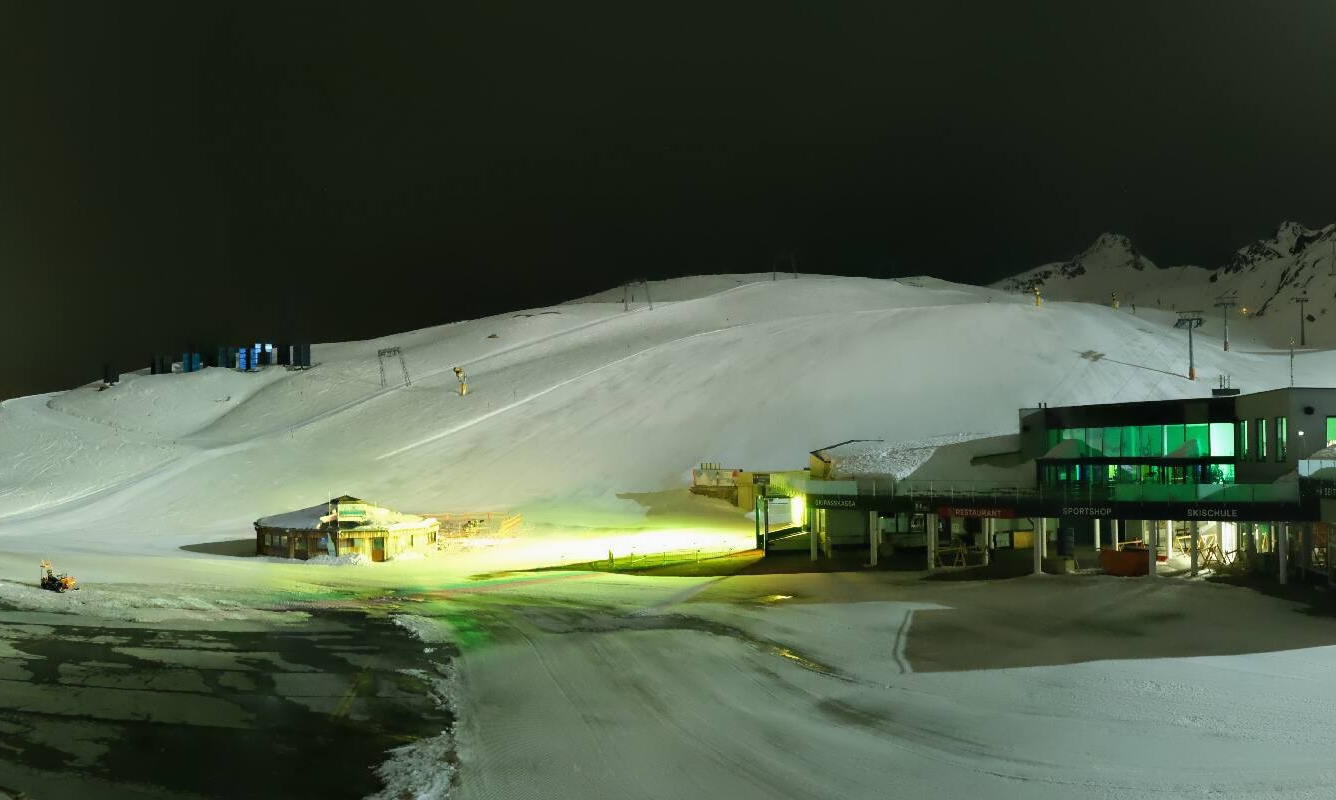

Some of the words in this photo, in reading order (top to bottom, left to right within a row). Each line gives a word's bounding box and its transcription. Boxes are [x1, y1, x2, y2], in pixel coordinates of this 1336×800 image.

[955, 508, 1002, 518] RESTAURANT
[1062, 507, 1112, 516] SPORTSHOP
[1186, 508, 1238, 517] SKISCHULE
